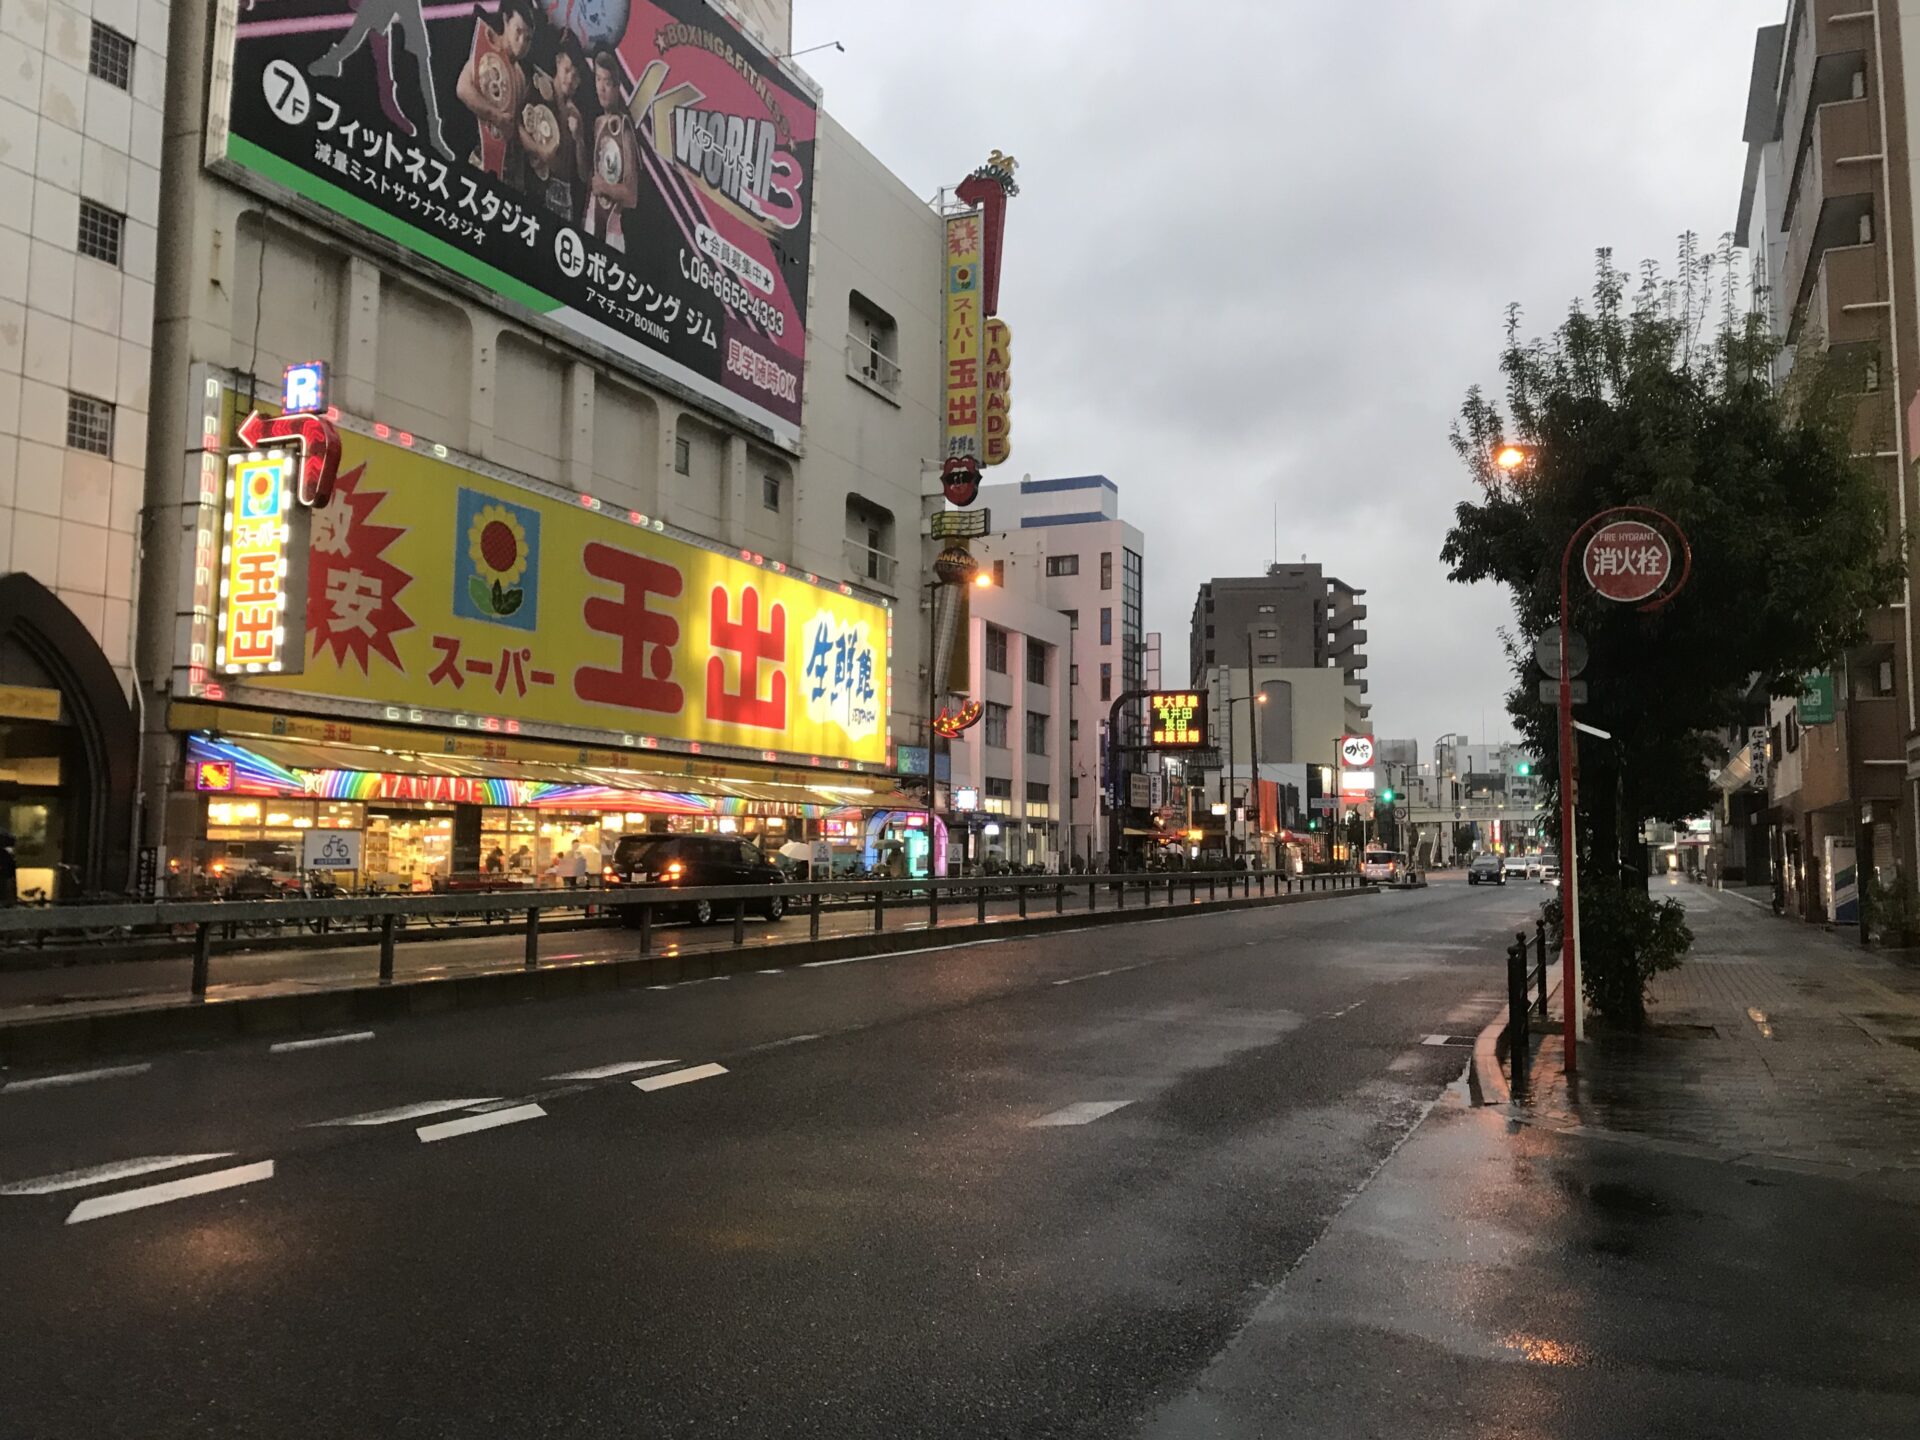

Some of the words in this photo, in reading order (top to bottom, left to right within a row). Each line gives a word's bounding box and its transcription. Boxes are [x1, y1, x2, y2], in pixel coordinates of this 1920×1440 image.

[273, 66, 305, 117] 7F
[315, 92, 450, 200] フィットネス
[457, 175, 541, 247] スタジオ
[708, 236, 764, 284] 会員募集中
[560, 234, 582, 272] 8F
[586, 251, 681, 323] ボクシング
[686, 307, 718, 350] ジム
[585, 287, 670, 344] アマチュアBOXING
[690, 255, 785, 337] 06-6652-4333
[726, 337, 797, 403] 見学随時OK
[947, 358, 978, 426] 玉出
[986, 325, 1006, 458] TAMADE
[1593, 545, 1663, 576] 消火栓
[1600, 533, 1617, 541] FIRE
[1619, 532, 1655, 541] HYDRANT
[231, 554, 278, 659] 玉出
[428, 635, 556, 698] スーパー
[573, 541, 787, 731] 玉出
[1153, 694, 1199, 708] 東大阪線
[1159, 707, 1193, 719] 高井田
[1165, 719, 1188, 731] 長田
[381, 773, 484, 801] TAMADE
